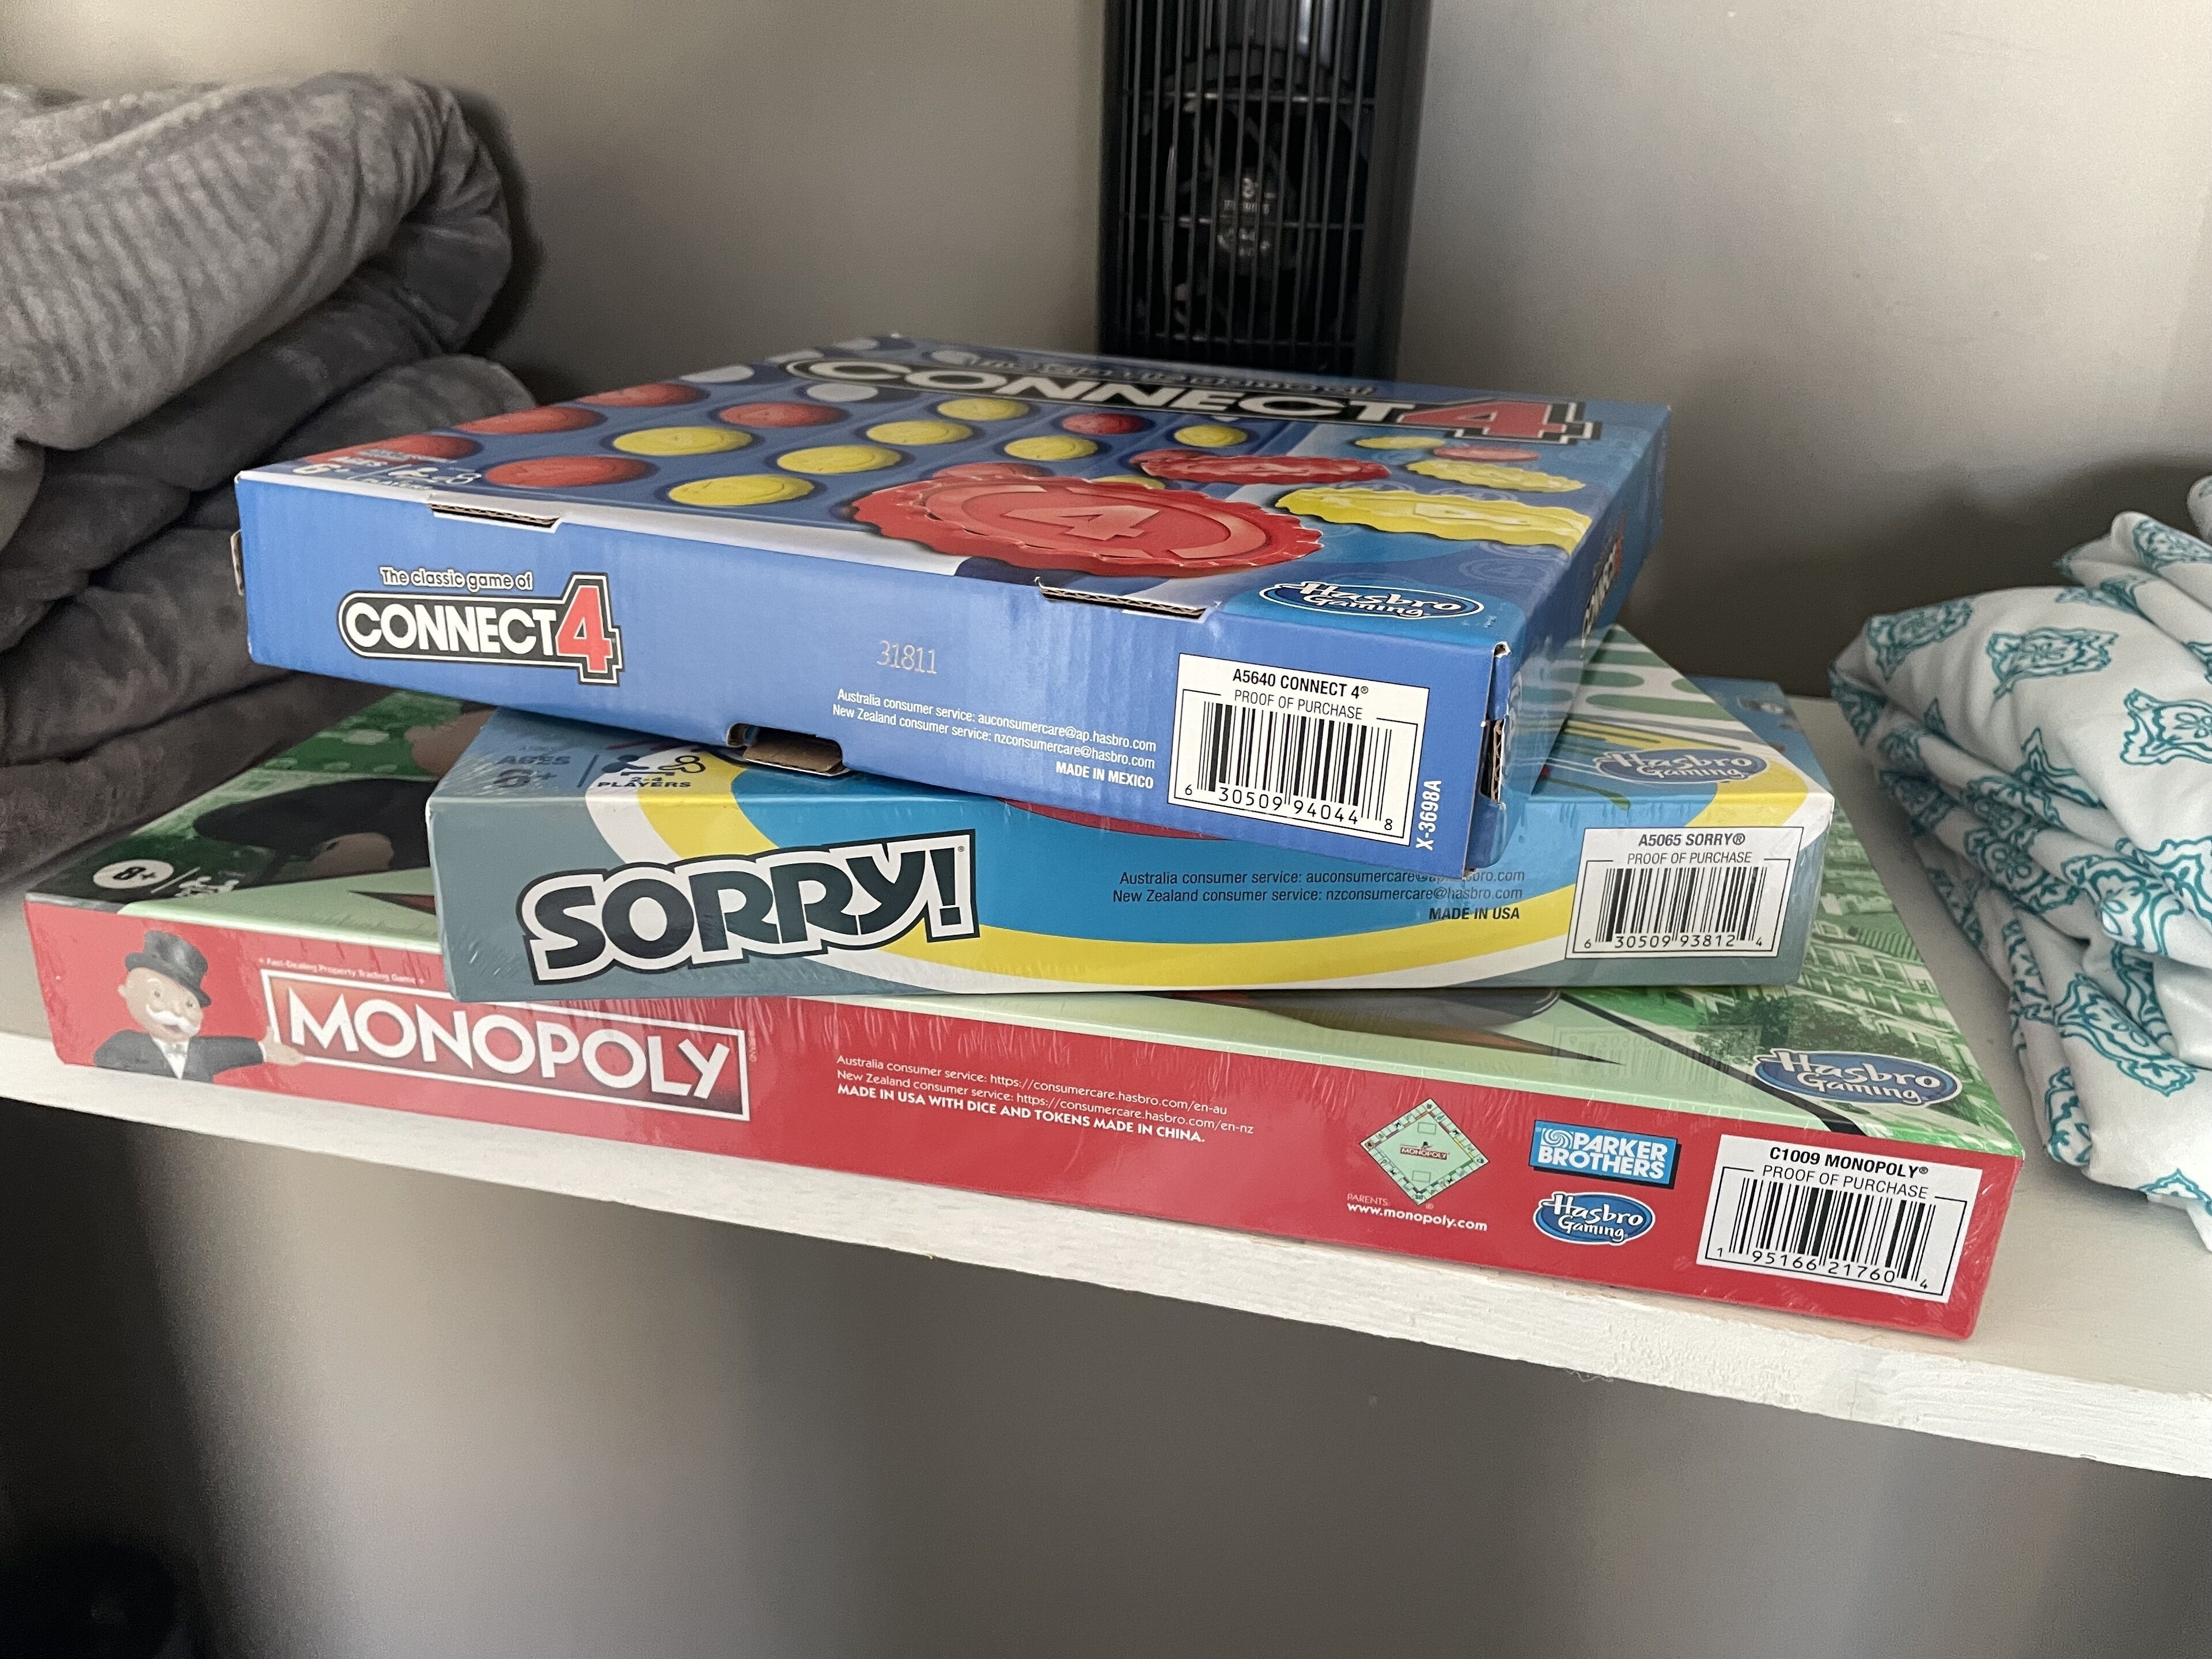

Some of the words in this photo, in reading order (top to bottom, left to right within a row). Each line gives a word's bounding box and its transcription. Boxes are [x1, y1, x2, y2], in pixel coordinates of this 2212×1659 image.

[808, 360, 1415, 422] CONNECT
[381, 566, 408, 586] The
[411, 568, 465, 589] classic
[467, 574, 513, 593] game
[516, 571, 533, 591] of
[1299, 582, 1462, 611] Hasbro
[1303, 594, 1427, 618] Gaming
[346, 601, 559, 657] CONNECT
[556, 585, 613, 673] 4
[877, 640, 937, 675] 31811
[1233, 668, 1275, 687] A5640
[1281, 676, 1347, 697] CONNECT
[838, 688, 881, 706] Australia
[884, 698, 933, 714] consumer
[936, 708, 975, 722] service:
[978, 714, 1156, 752] auconsumercare@ap.hasbro.com
[1234, 690, 1274, 706] PROOF
[1279, 696, 1294, 709] OF
[1298, 699, 1363, 720] PURCHASE
[833, 704, 854, 718] New
[857, 708, 896, 725] Zealand
[899, 718, 949, 734] consumer
[952, 726, 991, 741] service:
[994, 733, 1155, 768] nzconsumercare@hasbro.com
[1056, 761, 1090, 778] MADE
[1093, 767, 1104, 781] IN
[1108, 770, 1153, 789] MEXICO
[1612, 752, 1752, 768] Hasbro
[1637, 764, 1744, 779] Gaming
[1185, 785, 1192, 796] 6
[1219, 787, 1282, 811] 30509
[1294, 800, 1358, 824] 94044
[1385, 819, 1392, 831] 8
[1416, 779, 1442, 850] X-3698A
[1638, 834, 1681, 846] A5065
[1627, 853, 1667, 865] PROOF
[1671, 853, 1686, 863] OF
[1690, 852, 1752, 863] PURCHASE
[1120, 871, 1178, 884] Australia
[1183, 873, 1247, 884] consumer
[1251, 870, 1302, 883] service:
[534, 847, 964, 969] SORRY!
[1113, 890, 1142, 902] New
[1146, 889, 1198, 902] Zealand
[1203, 891, 1268, 902] consumer
[1271, 888, 1322, 901] service:
[1326, 887, 1522, 902] nzconsumercare@hasbro.com
[1429, 907, 1469, 920] MADE
[1474, 907, 1488, 919] IN
[1492, 907, 1520, 920] USA
[1585, 938, 1592, 948] 6
[1615, 935, 1671, 949] 30509
[1680, 935, 1735, 948] 93812
[1755, 937, 1763, 946] 4
[288, 987, 730, 1100] MONOPOLY
[837, 1055, 884, 1069] Australia
[887, 1063, 942, 1077] consumer
[945, 1070, 987, 1082] service:
[990, 1074, 1227, 1115] https://consumercare.hasbro.com/en-au
[1779, 1051, 1941, 1088] Hasbro
[837, 1070, 863, 1081] New
[866, 1074, 910, 1088] Zealand
[913, 1082, 969, 1096] consumer
[971, 1089, 1013, 1101] service:
[1016, 1094, 1255, 1134] https://consumercare.hasbro.com/en-nz
[1797, 1071, 1923, 1104] Gaming
[838, 1084, 876, 1099] MADE
[880, 1089, 894, 1100] IN
[898, 1092, 926, 1105] USA
[928, 1095, 964, 1110] WITH
[967, 1101, 997, 1114] DICE
[1000, 1104, 1031, 1119] AND
[1035, 1109, 1090, 1127] TOKENS
[1093, 1119, 1134, 1133] MADE
[1137, 1123, 1153, 1135] IN
[1156, 1126, 1205, 1142] CHINA.
[1401, 1147, 1448, 1159] MONOPOLY
[1572, 1131, 1668, 1162] PARKER
[1770, 1146, 1820, 1165] C1009
[1537, 1149, 1666, 1180] BROTHERS
[1763, 1165, 1815, 1183] PROOF
[1819, 1172, 1839, 1186] OF
[1843, 1176, 1929, 1199] PURCHASE
[1347, 1203, 1488, 1231] www.monopoly.com
[1551, 1194, 1644, 1227] Hasbro
[1558, 1215, 1625, 1243] Gaming
[1752, 1250, 1817, 1271] 95166
[1828, 1262, 1896, 1283] 21760
[1920, 1278, 1927, 1289] 4
